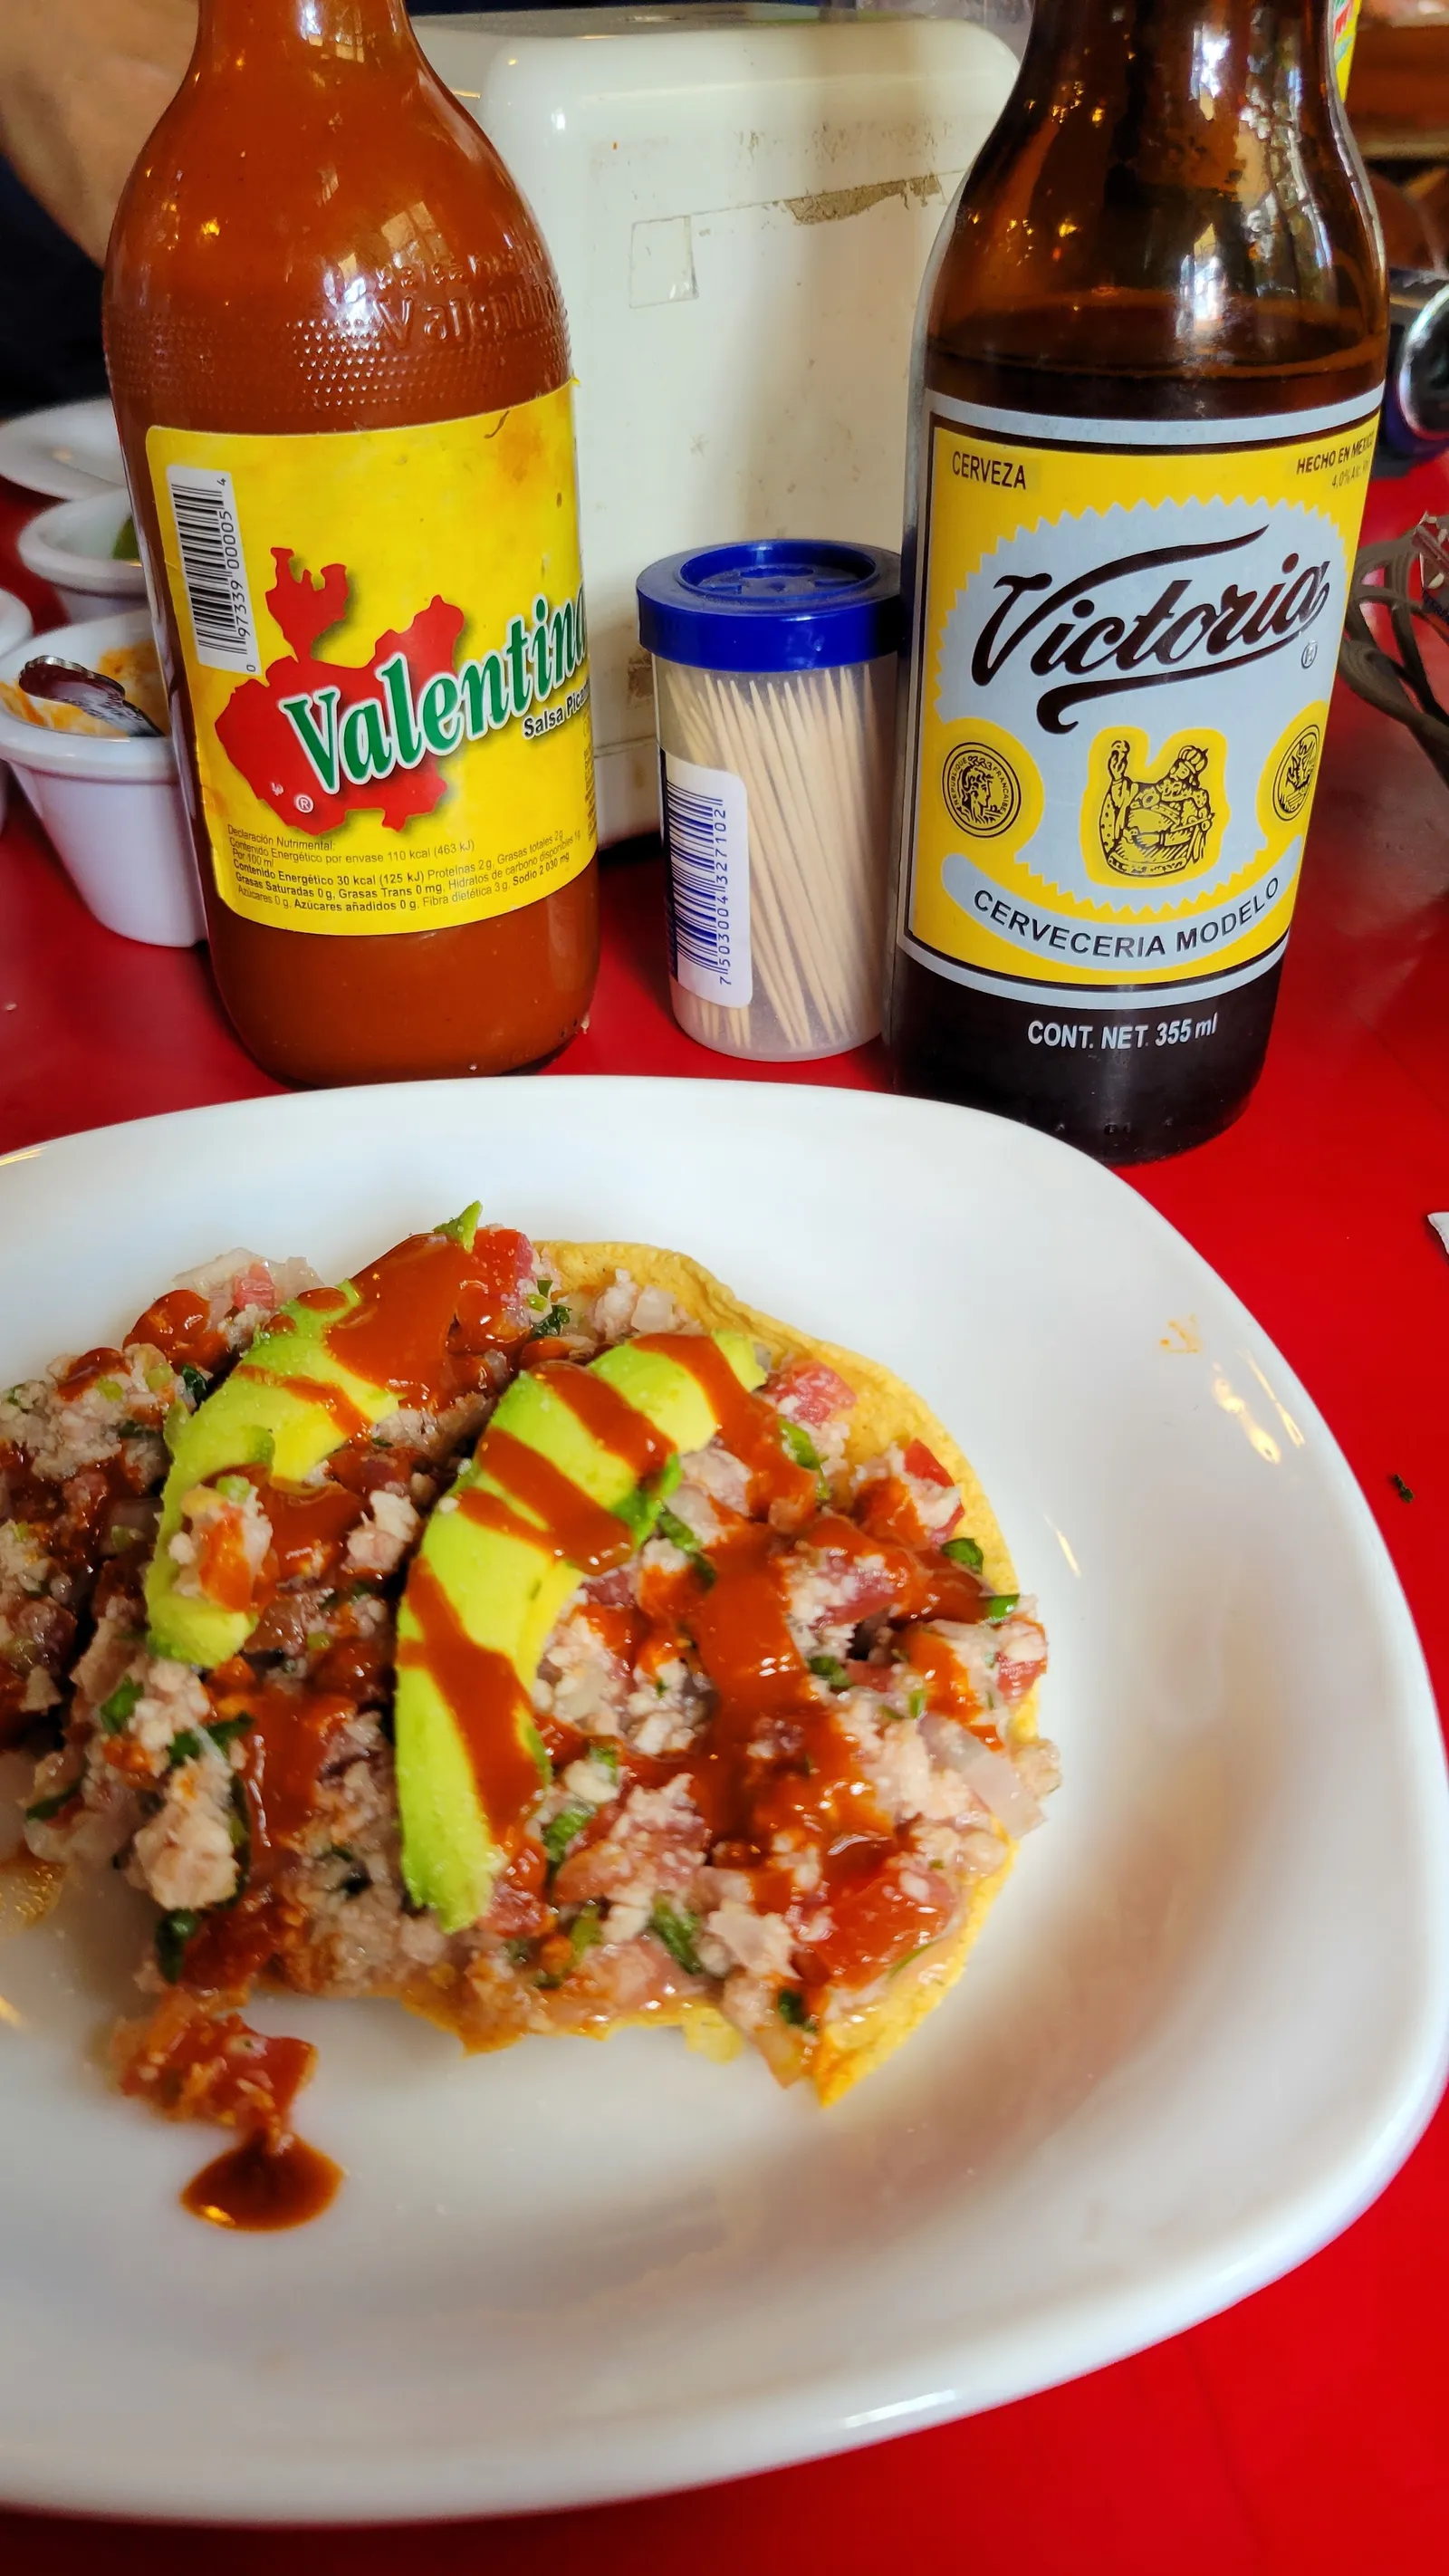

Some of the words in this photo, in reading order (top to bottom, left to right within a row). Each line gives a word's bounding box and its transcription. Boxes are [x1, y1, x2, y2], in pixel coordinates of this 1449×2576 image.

[952, 451, 1027, 490] CERVEZA
[1296, 450, 1336, 475] HECHO
[1338, 445, 1350, 464] EN
[219, 511, 240, 569] 00005
[231, 581, 251, 637] 97339
[971, 524, 1331, 735] Victoria
[246, 664, 256, 672] 0
[279, 582, 588, 794] Valentina
[523, 706, 564, 739] Salsa
[227, 823, 274, 845] Declaración
[276, 836, 336, 852] Nutrimental:
[229, 836, 270, 857] Contenido
[271, 847, 322, 863] Energético
[325, 854, 344, 864] por
[345, 853, 384, 863] envase
[388, 850, 407, 861] 110
[409, 847, 431, 860] kcal
[434, 843, 457, 860] (463
[459, 839, 475, 852] kJ)
[232, 847, 245, 860] Por
[247, 853, 262, 866] 100
[264, 858, 273, 868] ml
[234, 858, 276, 879] Contenido
[278, 870, 333, 886] Energético
[337, 875, 350, 886] 30
[353, 875, 376, 886] kcal
[379, 873, 403, 888] (125
[407, 870, 425, 884] kJ)
[497, 848, 528, 865] Grasas
[530, 835, 553, 853] totales
[235, 870, 264, 889] Grasas
[265, 880, 315, 898] Saturadas
[317, 888, 323, 898] 0
[339, 889, 378, 899] Grasas
[381, 887, 413, 899] Trans
[416, 884, 422, 895] 0
[448, 874, 489, 889] Hidratos
[492, 870, 503, 880] de
[505, 856, 538, 876] carbono
[540, 835, 574, 860] disponibles
[238, 885, 273, 904] Azúcares
[274, 893, 281, 905] 0
[294, 898, 342, 912] Azúcares
[346, 901, 397, 912] añadidos
[400, 899, 406, 909] 0
[423, 895, 449, 907] Fibra
[452, 885, 493, 903] dietética
[513, 870, 538, 886] Sodio
[546, 858, 558, 872] 030
[974, 889, 1166, 958] CERVECERIA
[1177, 877, 1279, 952] MODELO
[1028, 1020, 1094, 1050] CONT.
[1101, 1024, 1149, 1050] NET.
[1155, 1018, 1192, 1046] 355
[1195, 1013, 1218, 1040] ml
